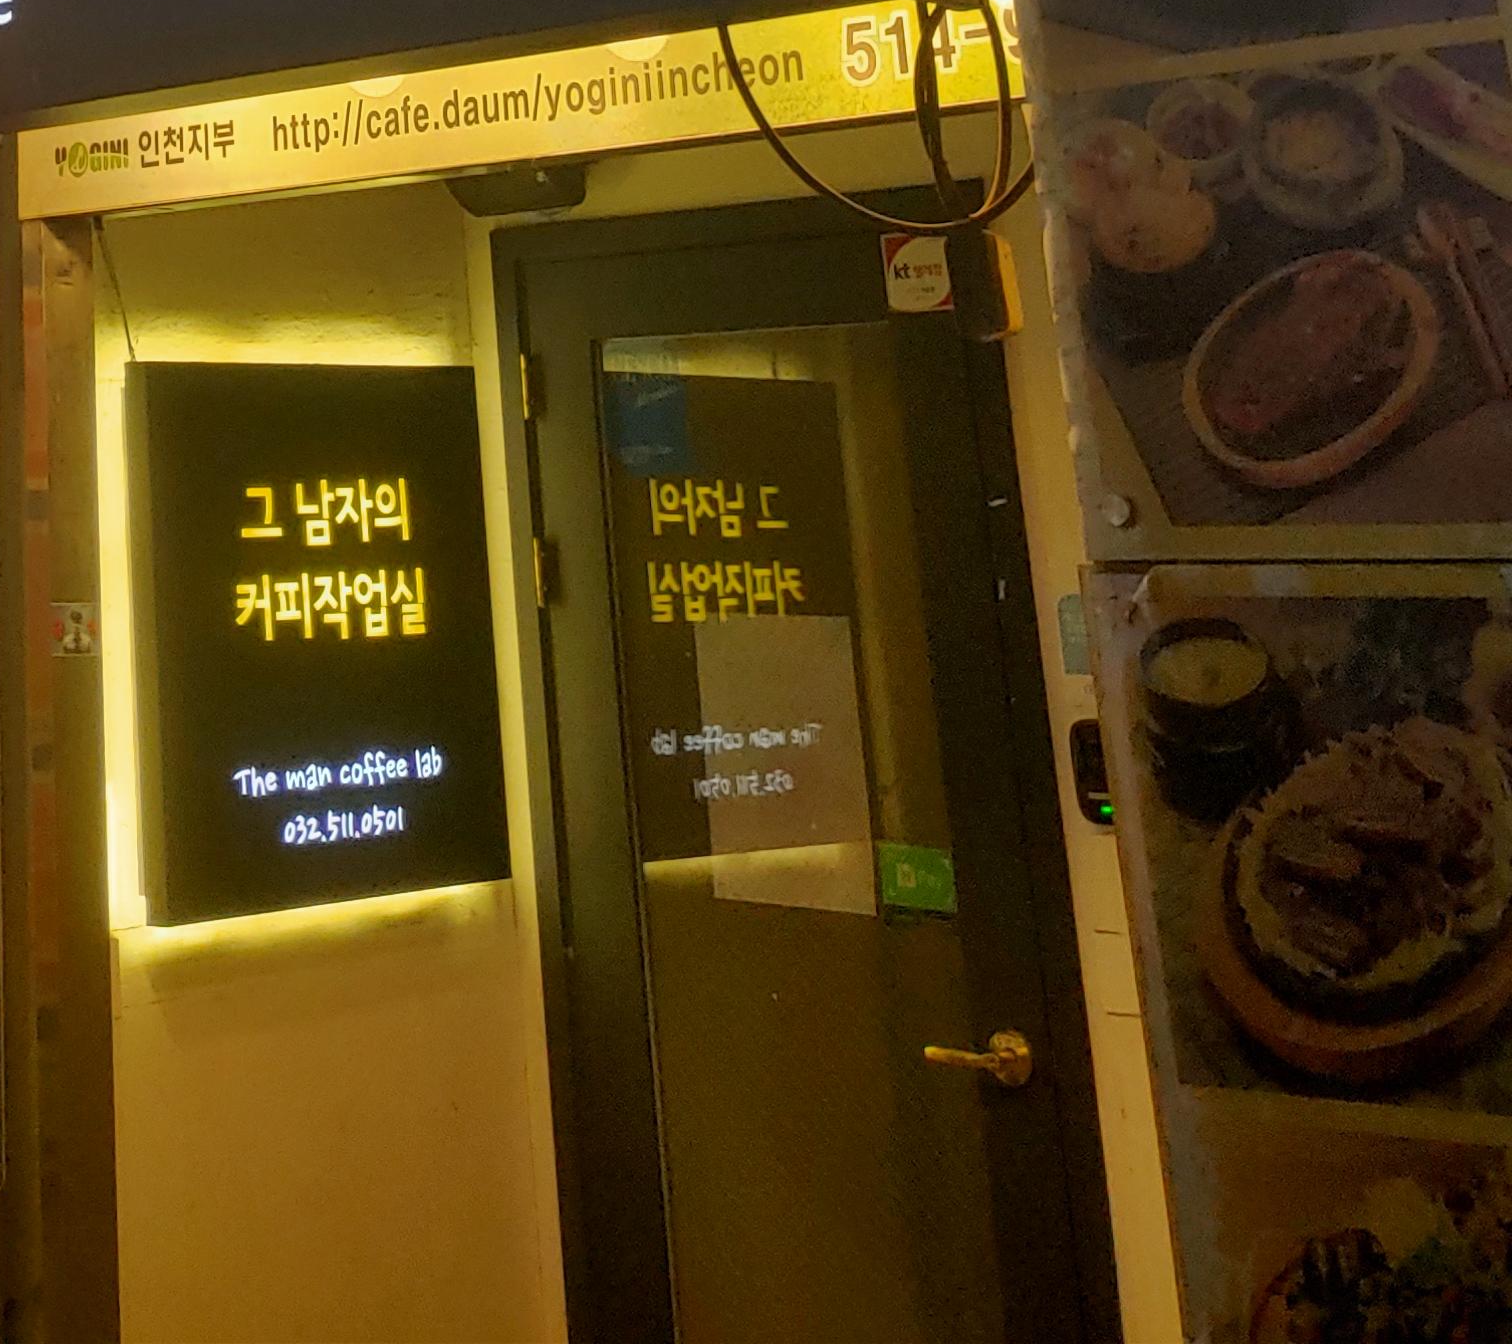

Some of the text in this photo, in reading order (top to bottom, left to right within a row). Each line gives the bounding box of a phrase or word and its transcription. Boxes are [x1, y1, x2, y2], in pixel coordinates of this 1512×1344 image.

[138, 120, 236, 169] 인천지부
[241, 478, 411, 547] 그 남자의
[234, 567, 427, 642] 커피작업실
[233, 745, 442, 798] The man coffee lab
